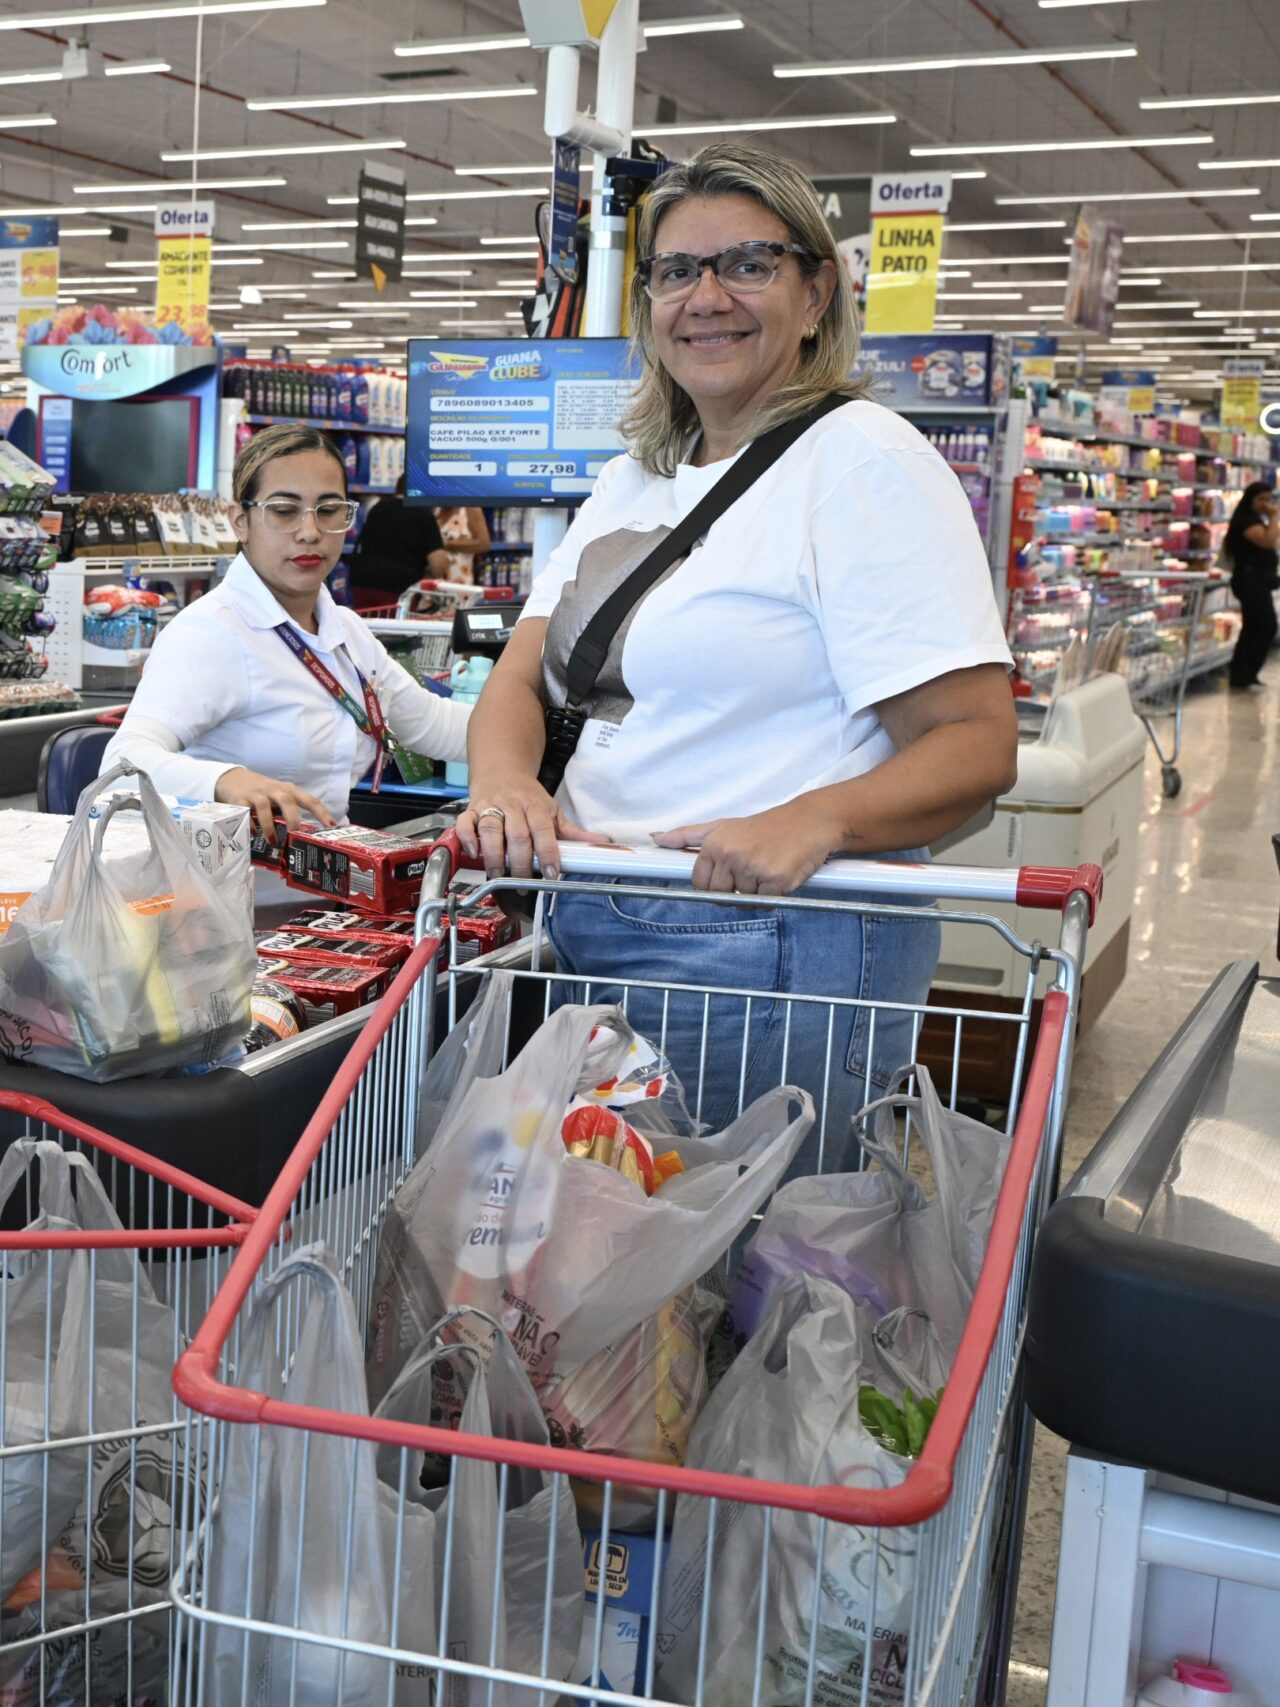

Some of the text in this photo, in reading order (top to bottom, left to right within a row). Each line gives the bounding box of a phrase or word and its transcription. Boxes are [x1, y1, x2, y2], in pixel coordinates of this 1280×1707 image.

[879, 182, 943, 200] Oferta
[161, 210, 208, 225] Oferta
[878, 229, 935, 248] LINHA
[881, 256, 927, 273] PATO
[61, 349, 132, 380] Comfort
[495, 350, 542, 366] GUANA
[491, 365, 540, 381] CLUBE
[474, 463, 481, 472] 1
[529, 464, 575, 474] 27,98
